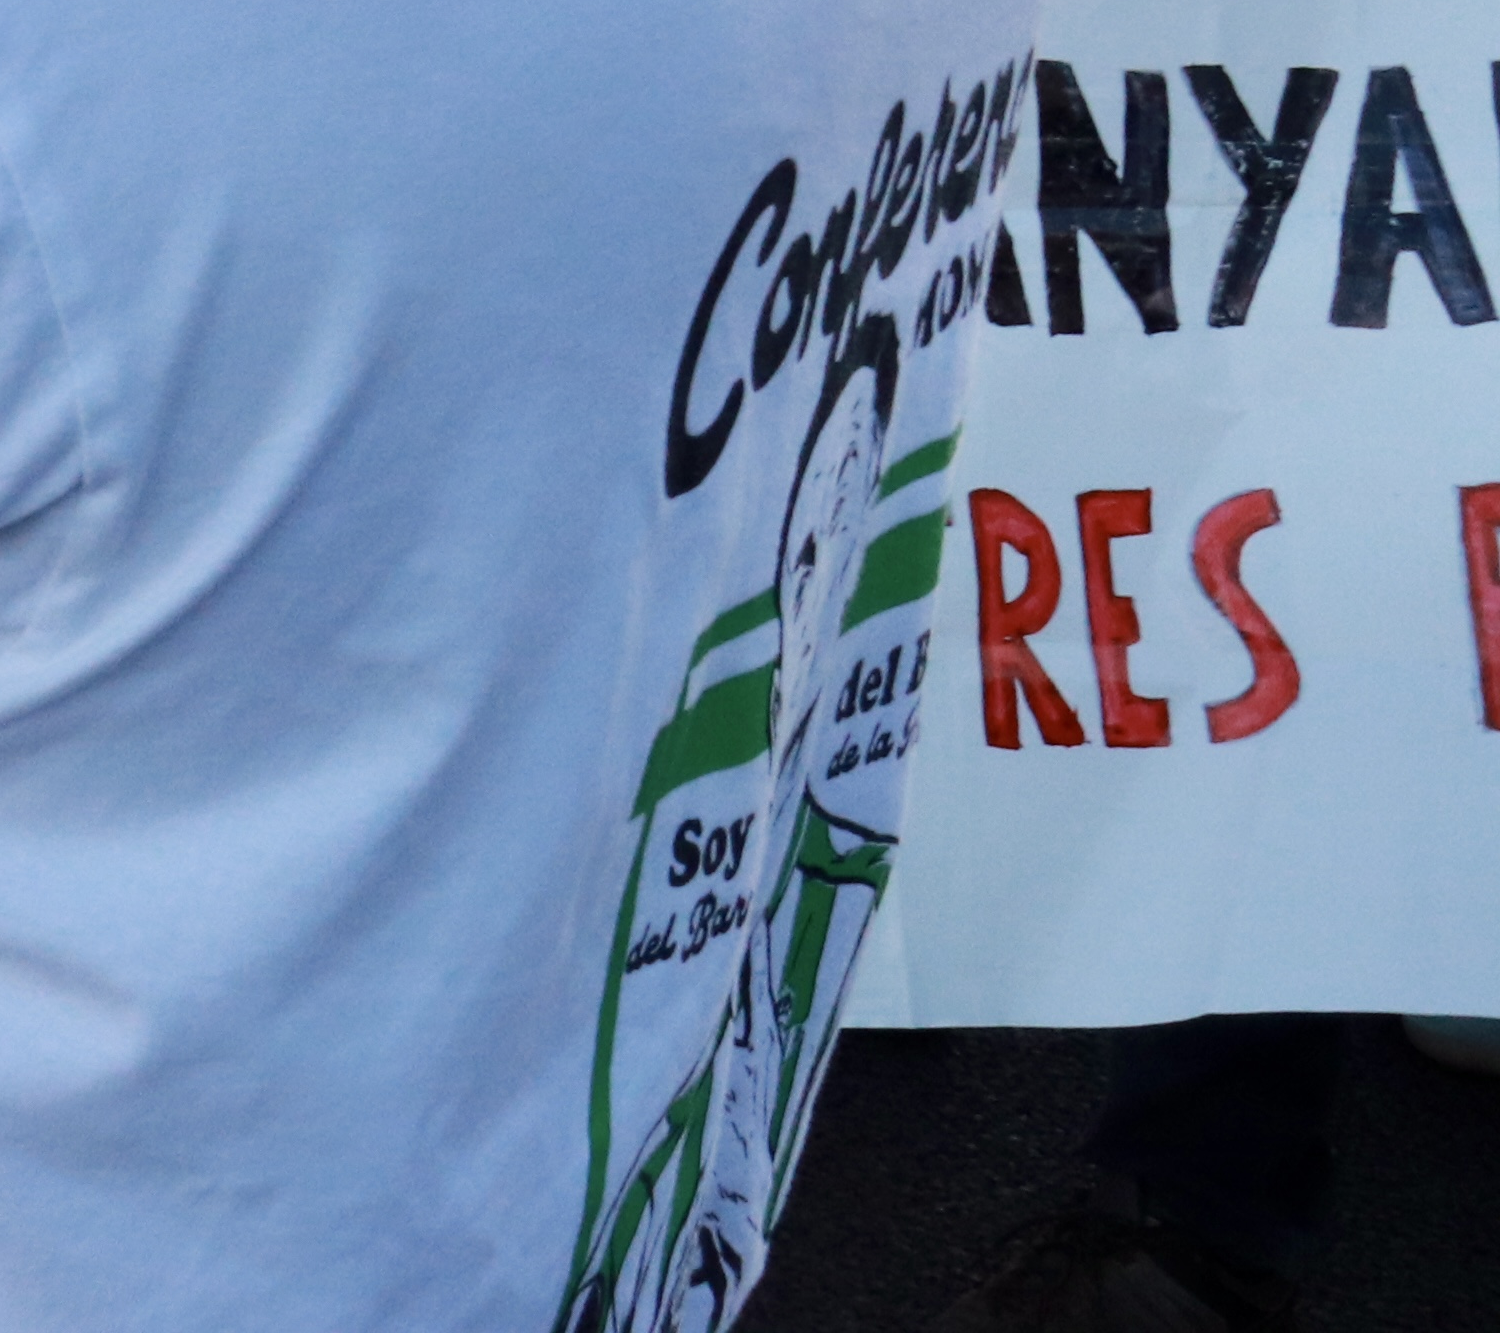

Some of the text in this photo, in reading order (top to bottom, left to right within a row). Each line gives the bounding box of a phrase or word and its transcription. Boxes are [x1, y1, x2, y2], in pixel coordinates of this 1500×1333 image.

[835, 644, 903, 723] del
[668, 813, 756, 888] Soy
[626, 912, 677, 974] del
